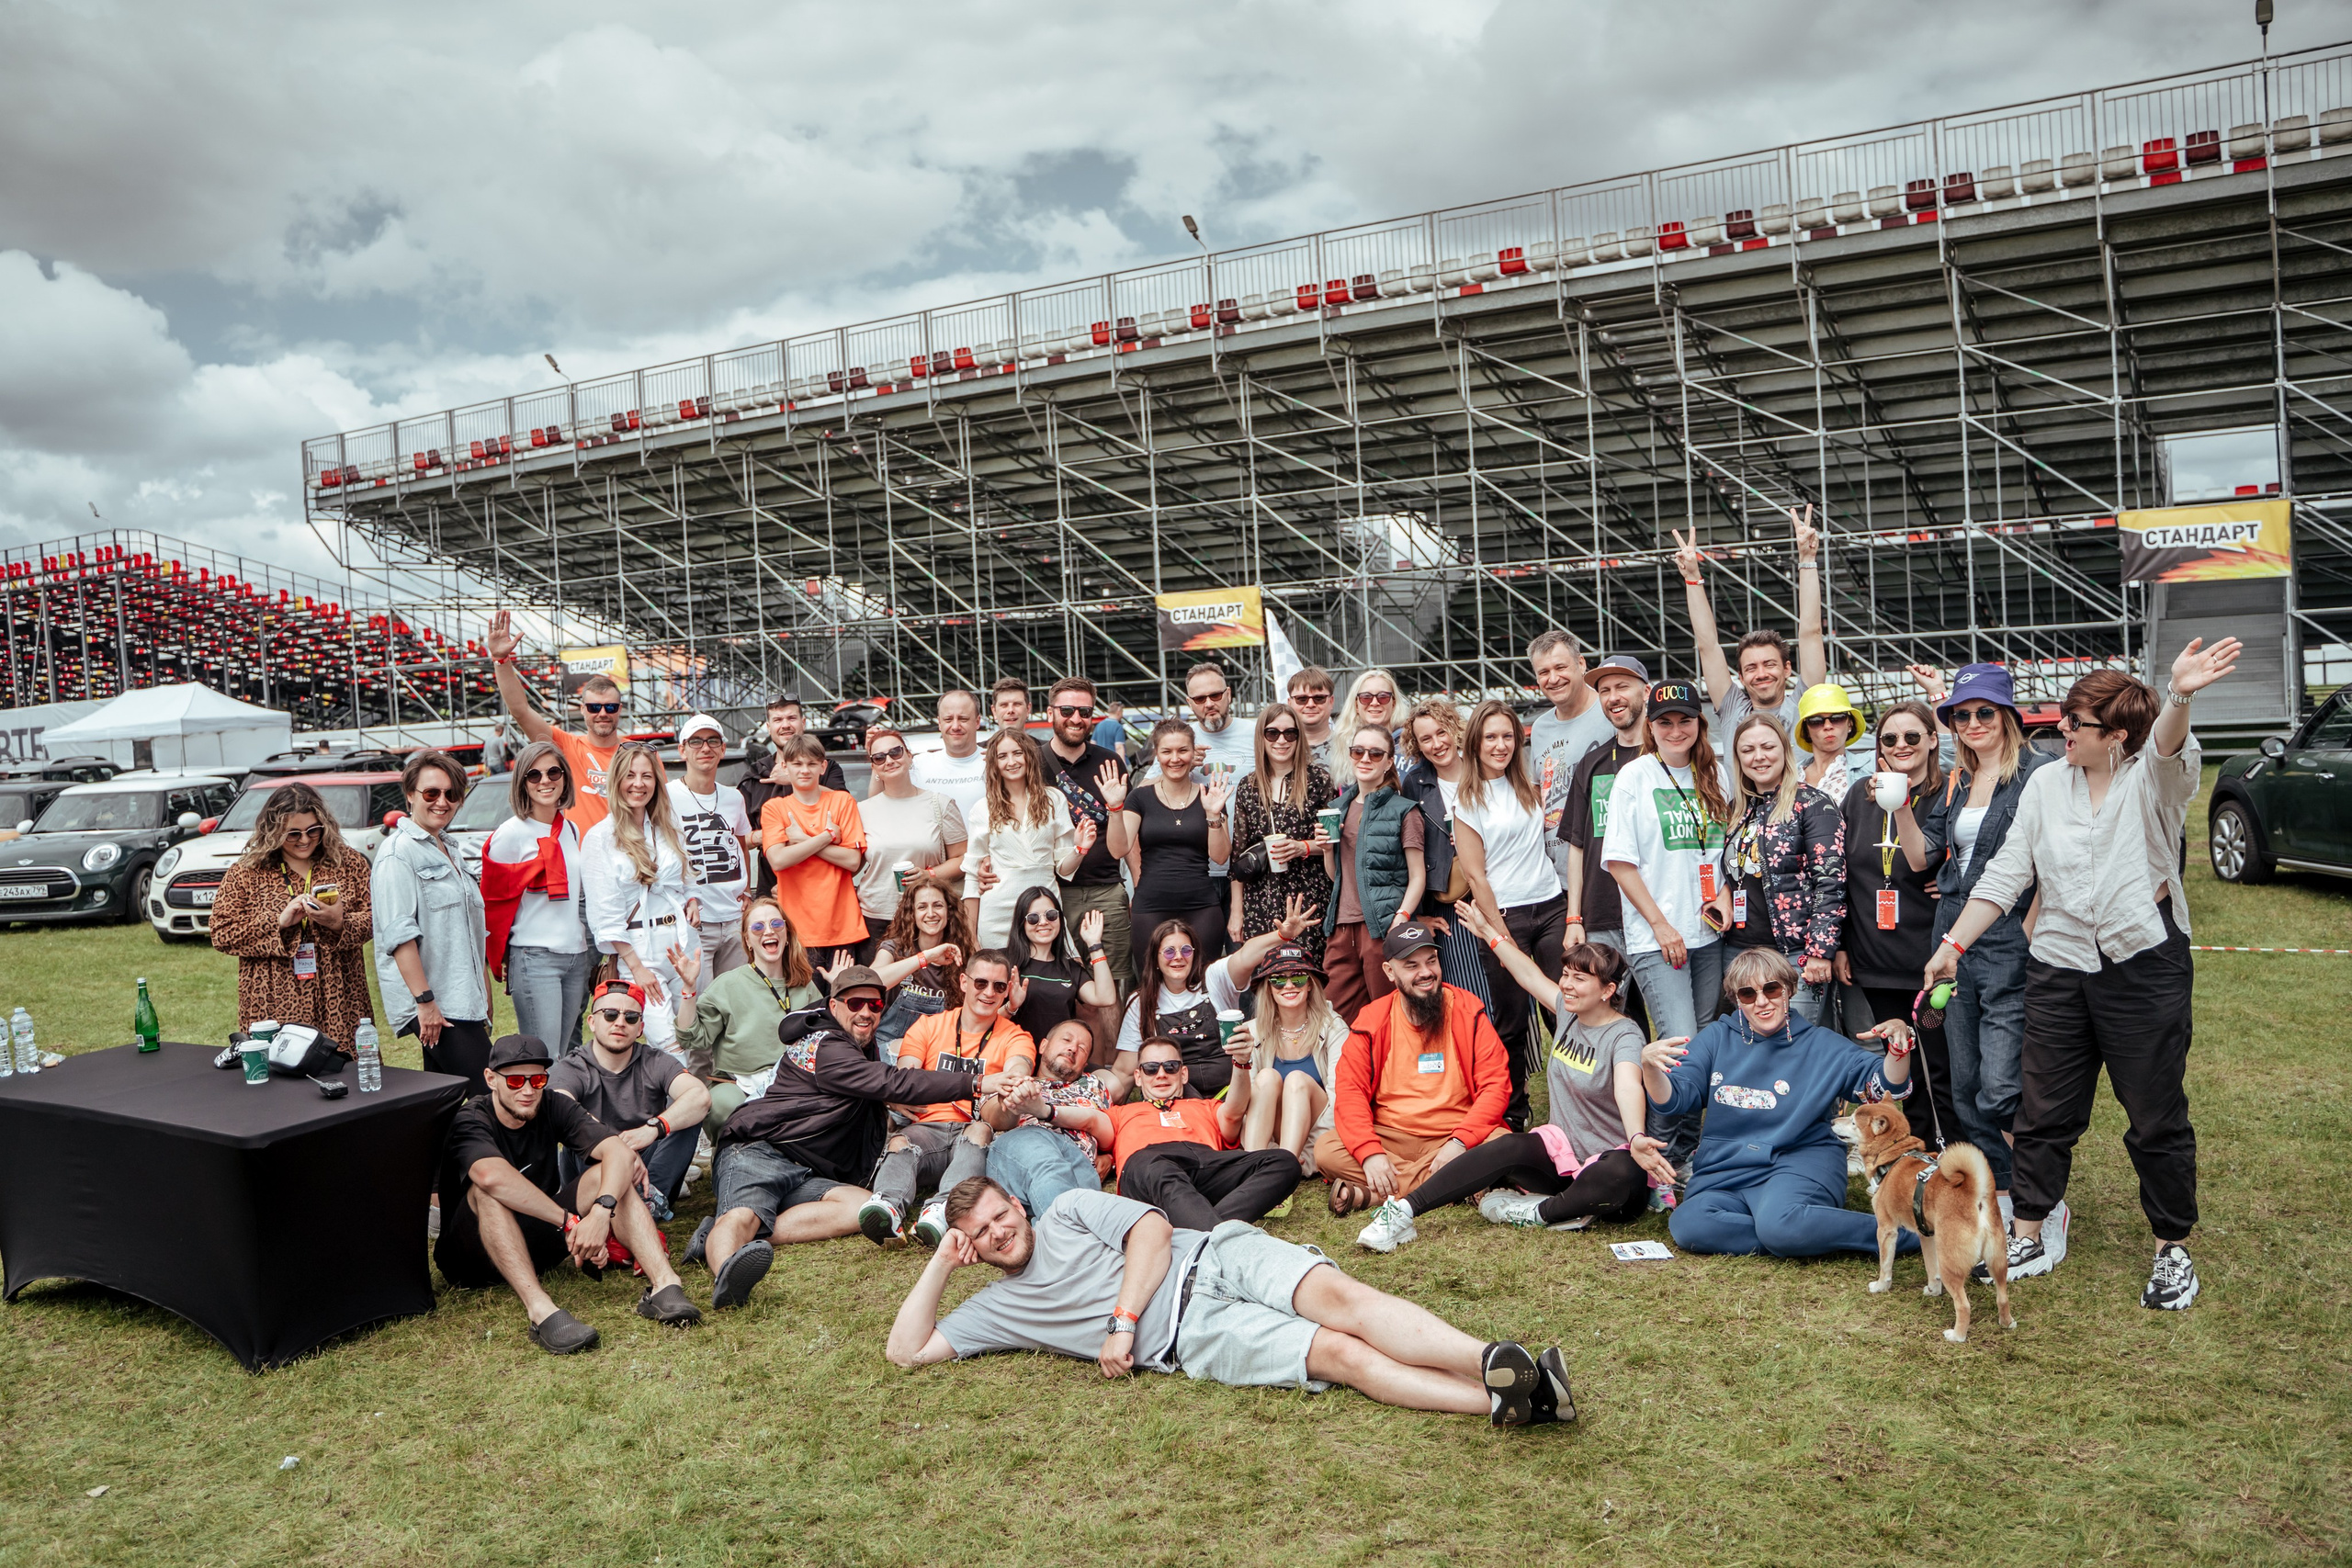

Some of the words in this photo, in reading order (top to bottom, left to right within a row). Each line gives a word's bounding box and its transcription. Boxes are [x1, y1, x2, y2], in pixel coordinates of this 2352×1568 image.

[2144, 523, 2259, 546] СТАНДАРТ
[1172, 604, 1243, 622] СТАНДАРТ
[570, 659, 615, 672] СТАНДАРТ
[1655, 685, 1690, 703] GUCCI
[1668, 823, 1694, 840] NOT
[1555, 1033, 1596, 1067] MINI
